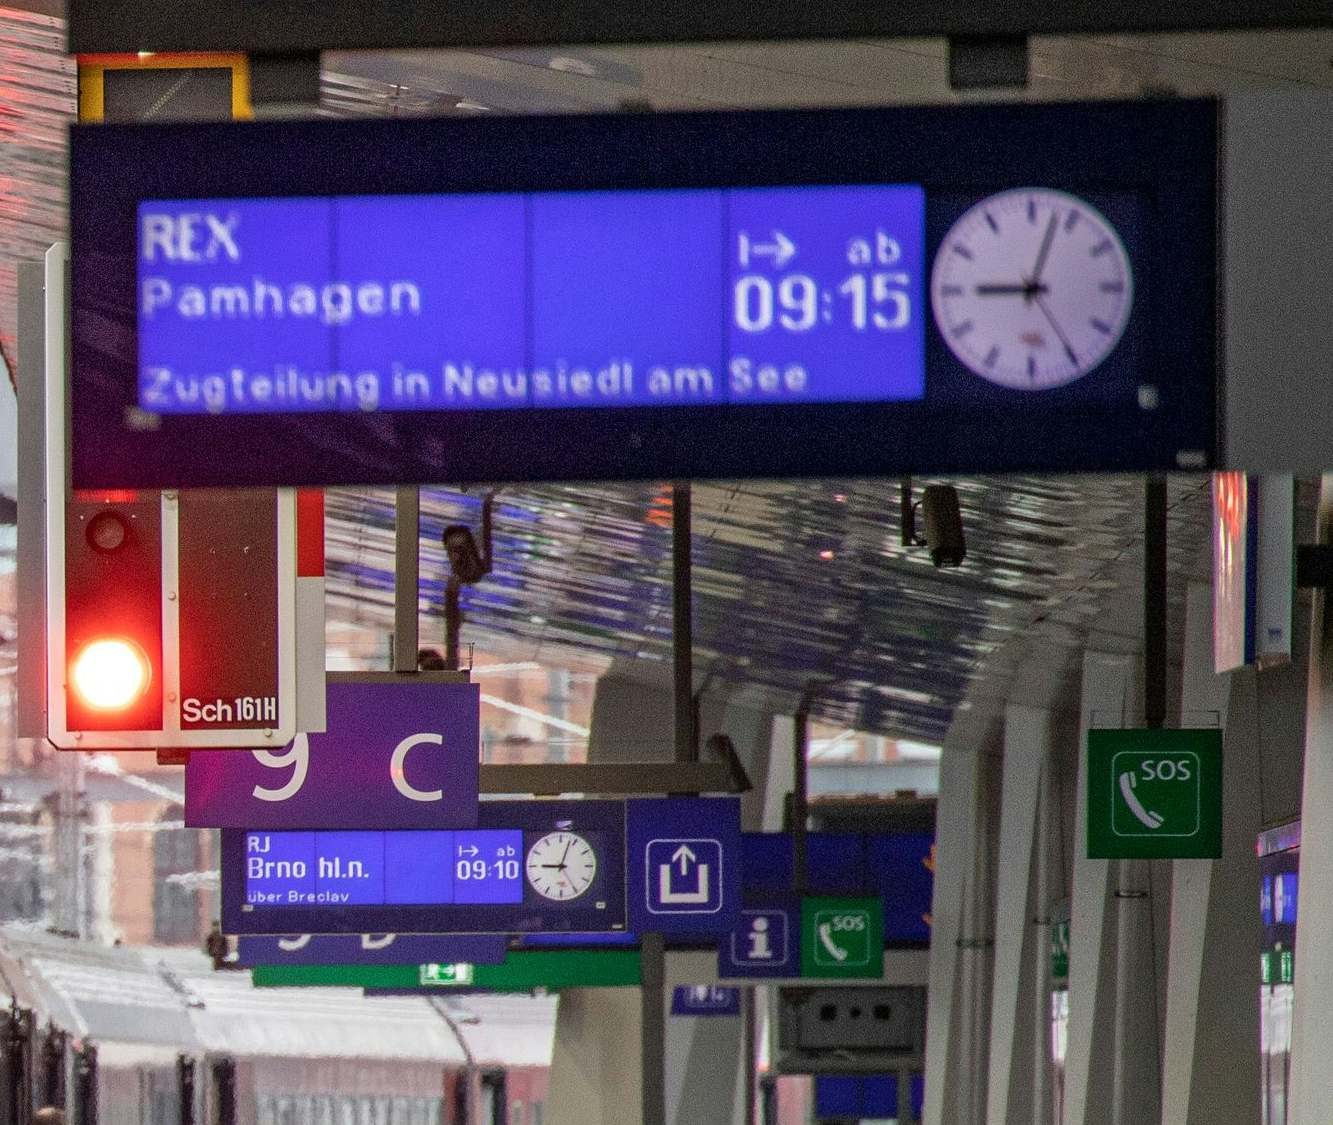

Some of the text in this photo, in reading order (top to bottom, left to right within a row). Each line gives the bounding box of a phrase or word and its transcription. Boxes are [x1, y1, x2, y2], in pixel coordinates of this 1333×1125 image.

[141, 211, 240, 262] REX
[847, 230, 902, 265] ab
[141, 277, 421, 325] Pamhagen
[733, 271, 912, 333] 09:15
[142, 357, 808, 413] Zugteilung in Neusiedl am See
[1141, 760, 1191, 780] SOS
[247, 836, 270, 852] RJ
[497, 847, 515, 856] ab
[247, 857, 369, 879] Brno hl.n.
[457, 860, 519, 880] 09:10
[247, 890, 349, 903] über Breclav
[833, 917, 865, 931] SOS
